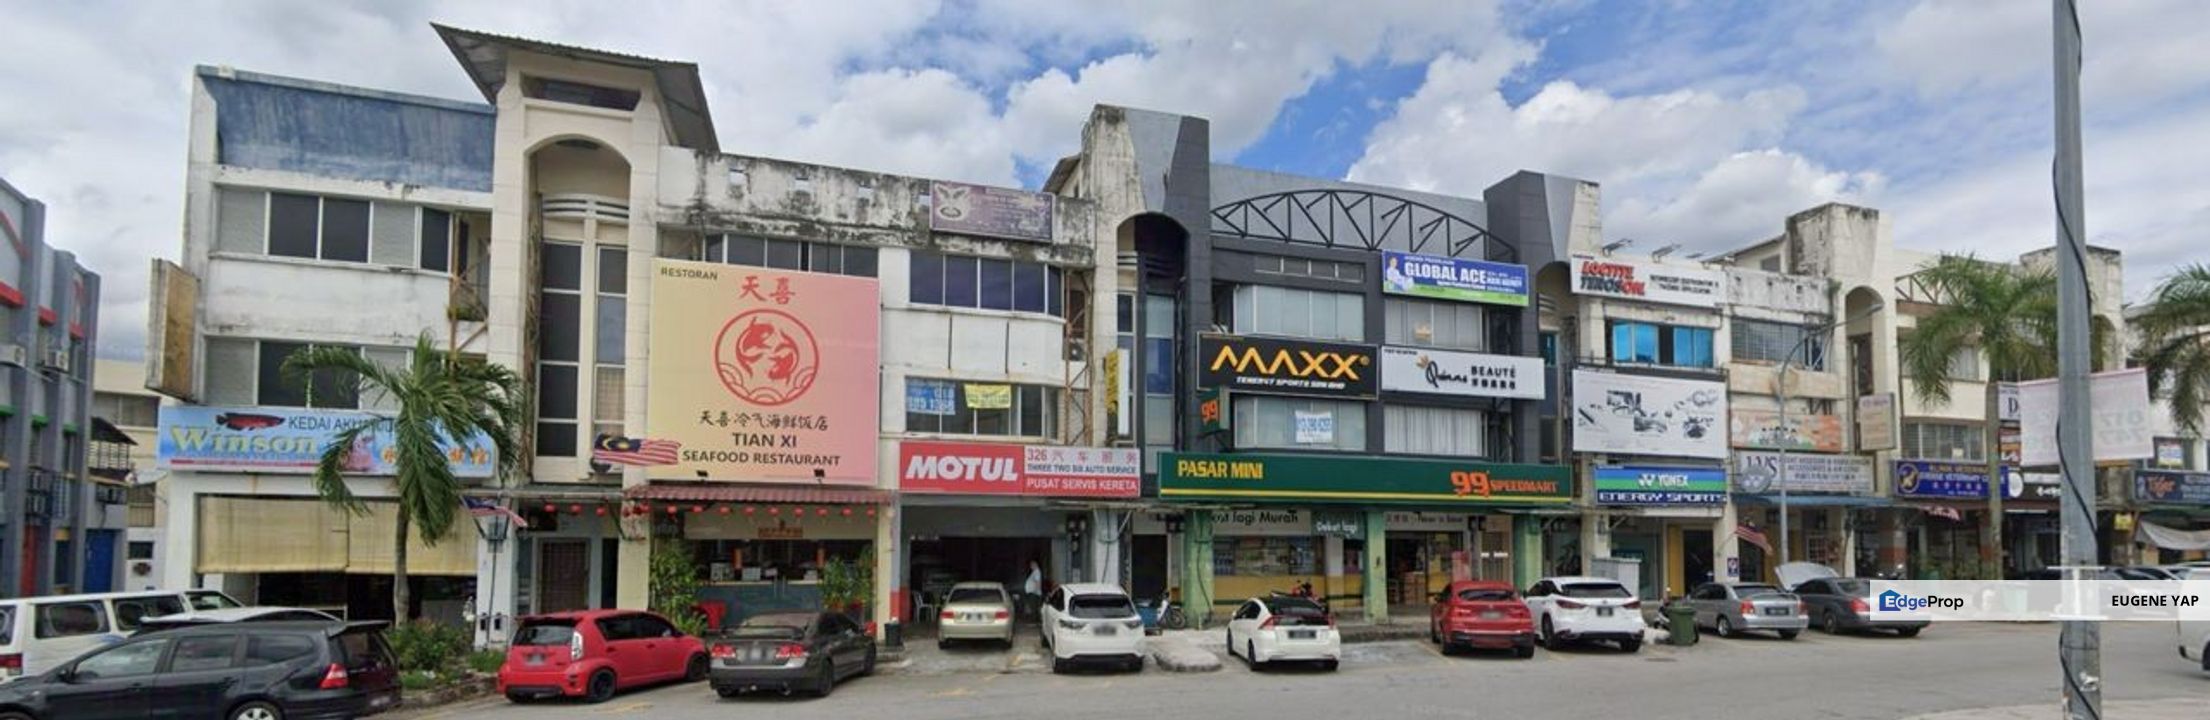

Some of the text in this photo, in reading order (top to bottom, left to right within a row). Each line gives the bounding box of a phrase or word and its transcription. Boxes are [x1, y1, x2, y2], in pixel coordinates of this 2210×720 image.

[661, 267, 718, 280] RESTORAN
[1404, 261, 1487, 285] GLOBAL ACE
[740, 275, 795, 305] 天喜
[1211, 345, 1359, 381] MAXX
[1471, 364, 1516, 378] BEAUTÉ
[1276, 378, 1308, 388] SPORTS
[1201, 400, 1218, 421] 99
[289, 416, 330, 430] KEDAI
[170, 425, 318, 453] Winson
[732, 432, 797, 448] TIAN XI
[682, 450, 841, 466] SEAFOOD RESTAURANT
[1027, 448, 1048, 461] 326
[905, 456, 1018, 481] MOTUL
[1178, 460, 1263, 479] PASAR MINI
[1027, 478, 1137, 491] PUSAT SERVIS KERETA
[1451, 470, 1557, 496] 99 SPEEDMART
[1658, 475, 1688, 486] YONEX
[1600, 492, 1663, 501] ENERGY
[1233, 511, 1256, 525] lagi
